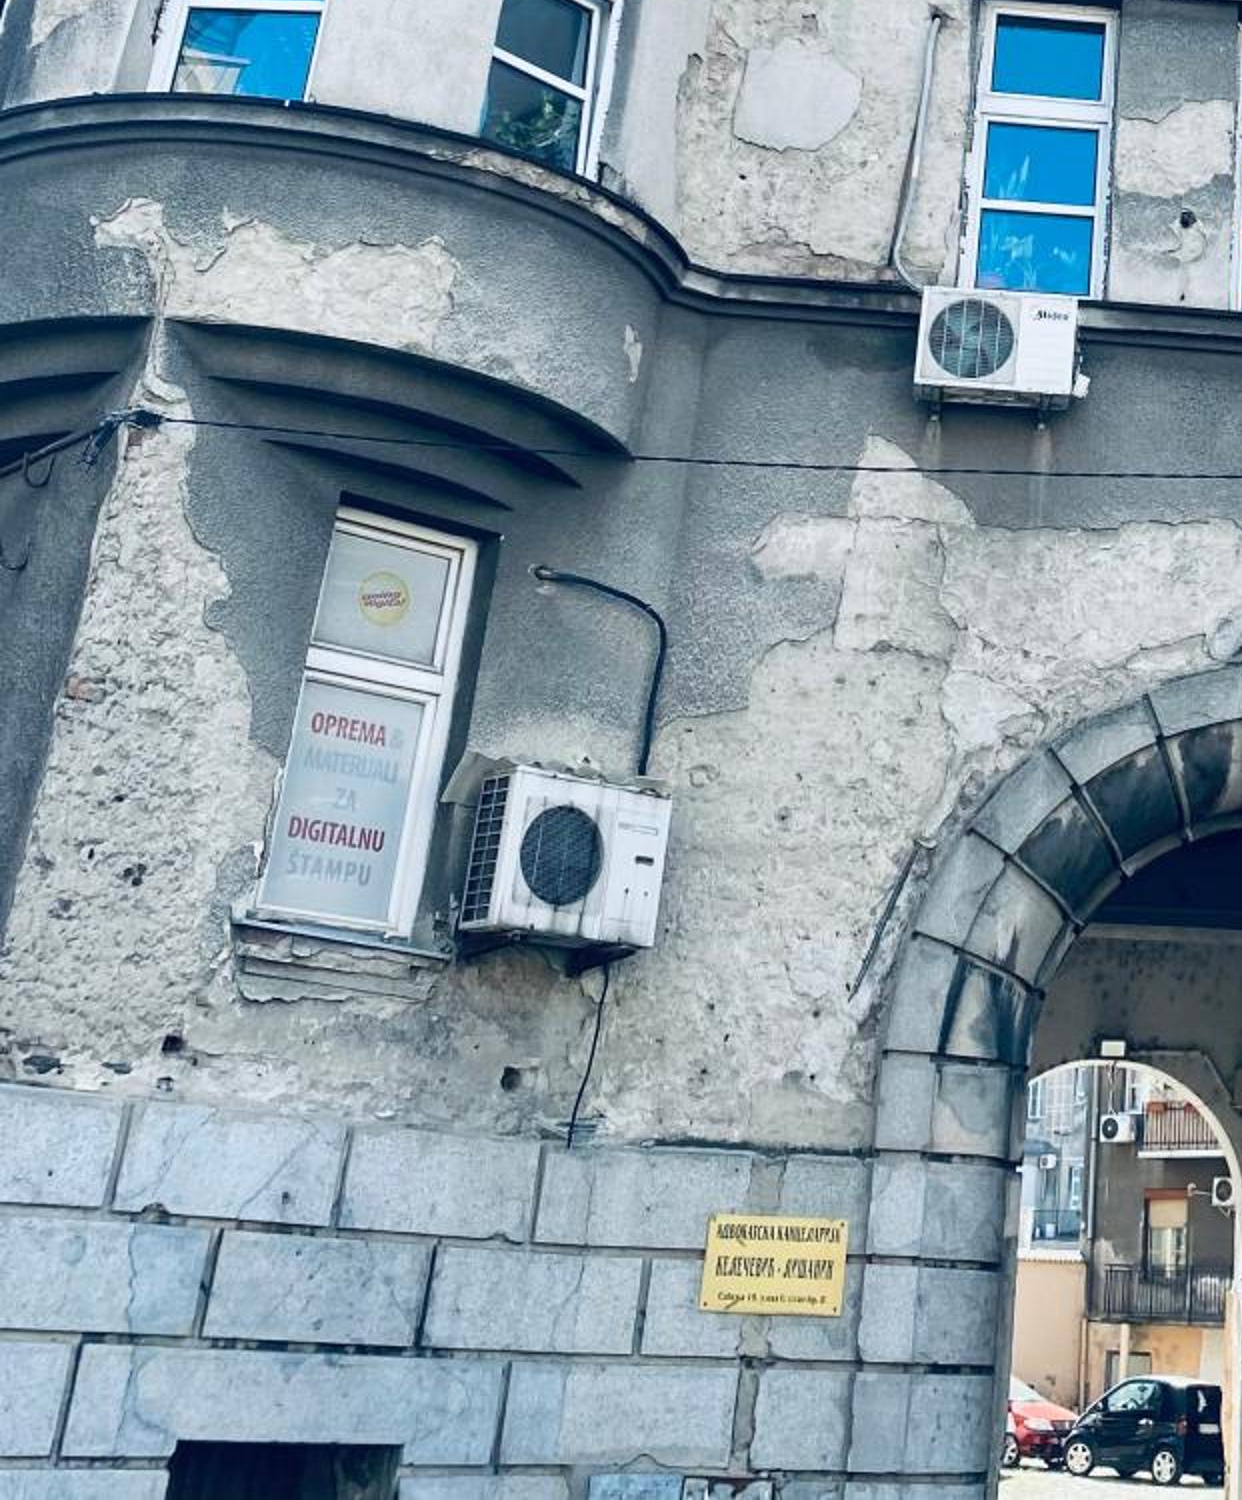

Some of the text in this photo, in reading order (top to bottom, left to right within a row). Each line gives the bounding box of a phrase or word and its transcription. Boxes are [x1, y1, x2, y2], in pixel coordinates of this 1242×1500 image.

[311, 711, 386, 747] OPREMA
[333, 787, 357, 813] ZA
[287, 814, 385, 853] DIGITALNU
